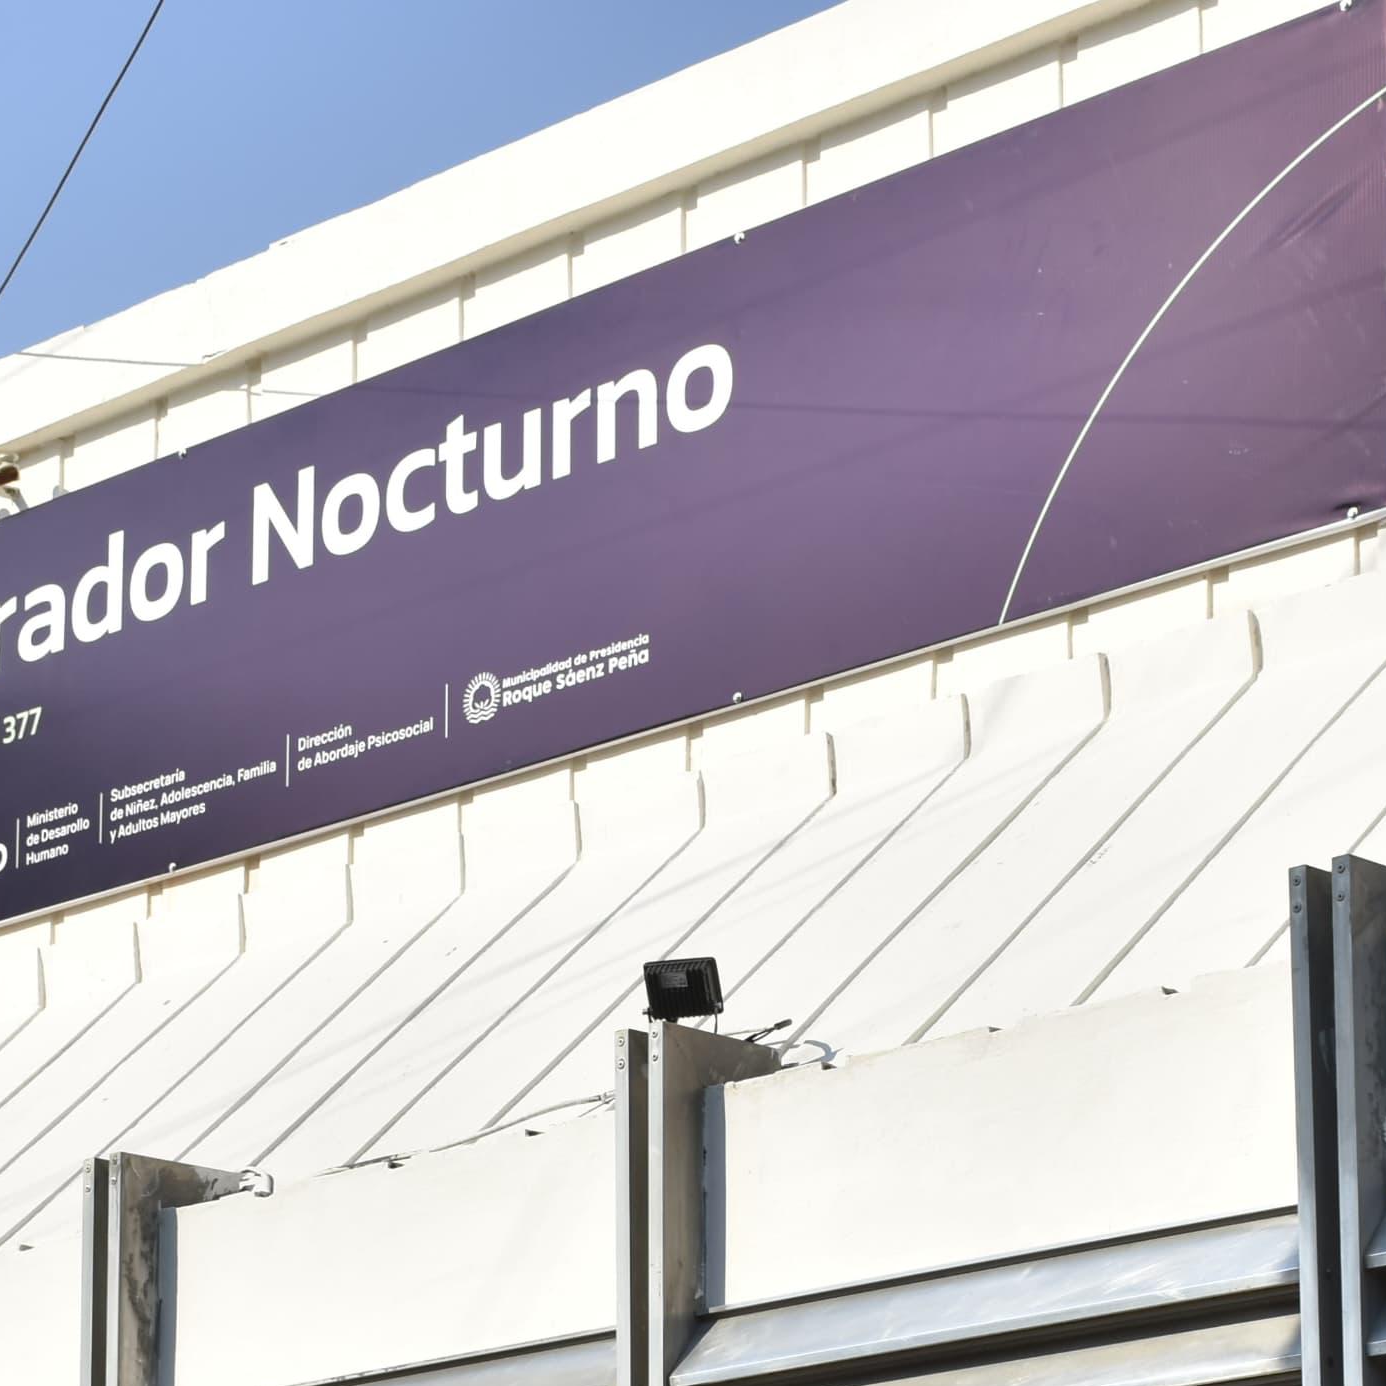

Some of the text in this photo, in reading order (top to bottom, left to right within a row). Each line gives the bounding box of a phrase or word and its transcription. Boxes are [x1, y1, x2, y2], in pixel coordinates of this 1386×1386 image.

[252, 343, 734, 586] Nocturno
[502, 633, 650, 689] Municipalidad de Presidencia
[502, 648, 650, 707] Roque Sáenz Peña
[2, 706, 43, 744] 377
[297, 723, 353, 752] Dirección
[297, 716, 434, 771] de Abordaje Psicosocial
[109, 760, 277, 822] de Niñez, Adolescencia, Familia
[110, 768, 186, 802] Subsecretaría
[26, 802, 79, 828] Ministerio
[26, 817, 90, 847] de Desarollo
[109, 801, 206, 844] y Adultos Mayores
[25, 843, 69, 866] Humano
